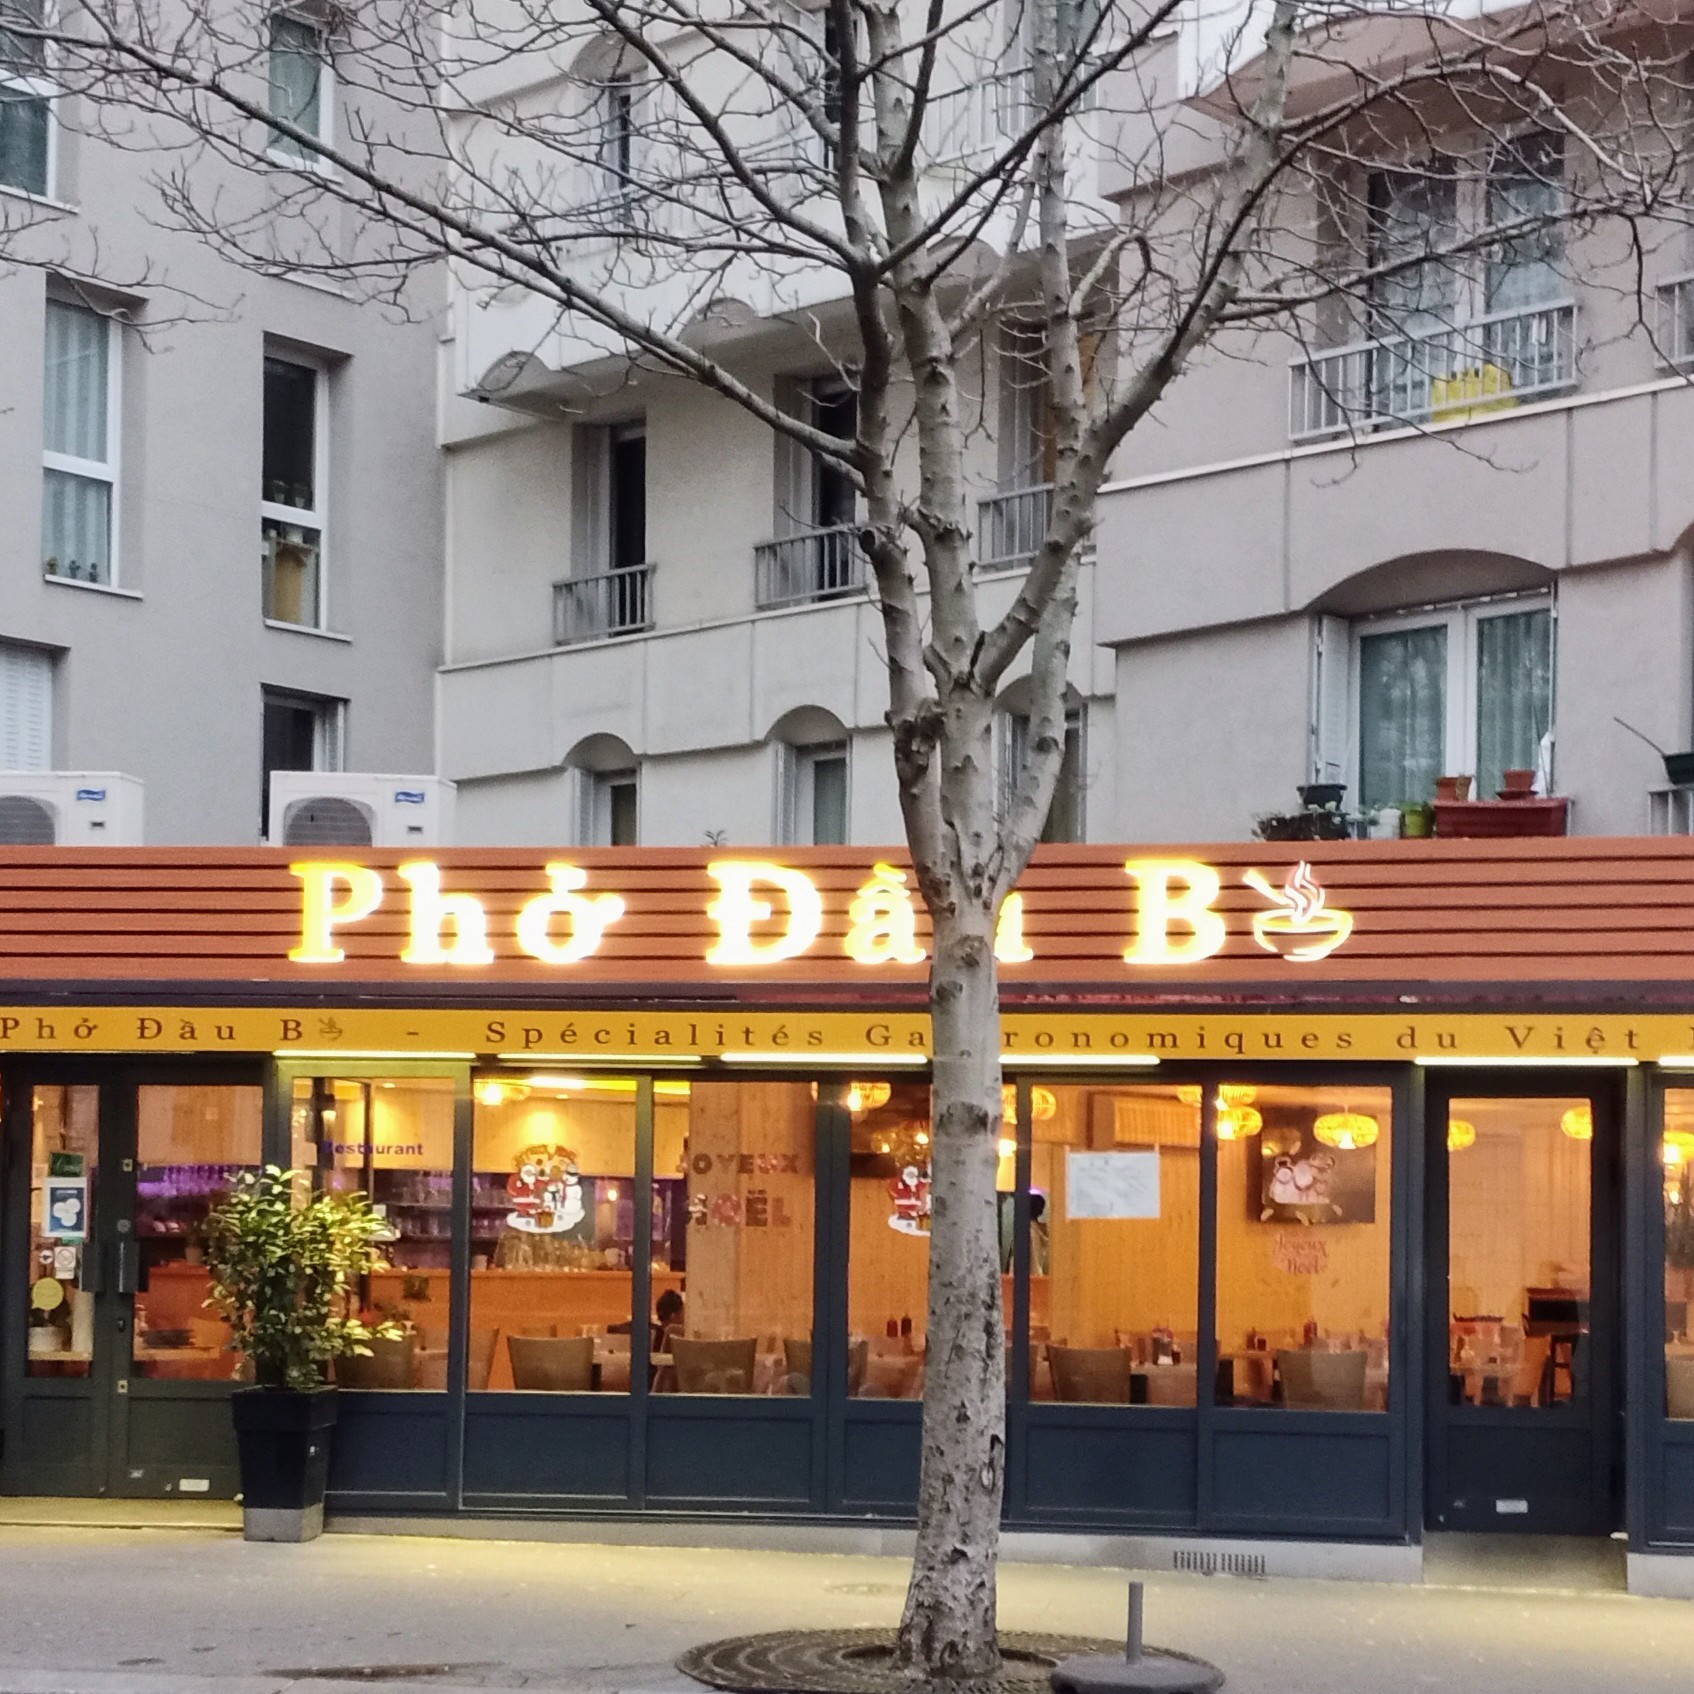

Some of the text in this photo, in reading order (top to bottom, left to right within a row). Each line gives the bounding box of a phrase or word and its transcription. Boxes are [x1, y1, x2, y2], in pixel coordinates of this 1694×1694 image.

[289, 860, 626, 966] Phở
[0, 1016, 99, 1041] Phở
[485, 1020, 824, 1050] Spécialités
[864, 1023, 1353, 1054] Garonomiques
[1396, 1025, 1458, 1049] du
[1503, 1024, 1640, 1055] Việt
